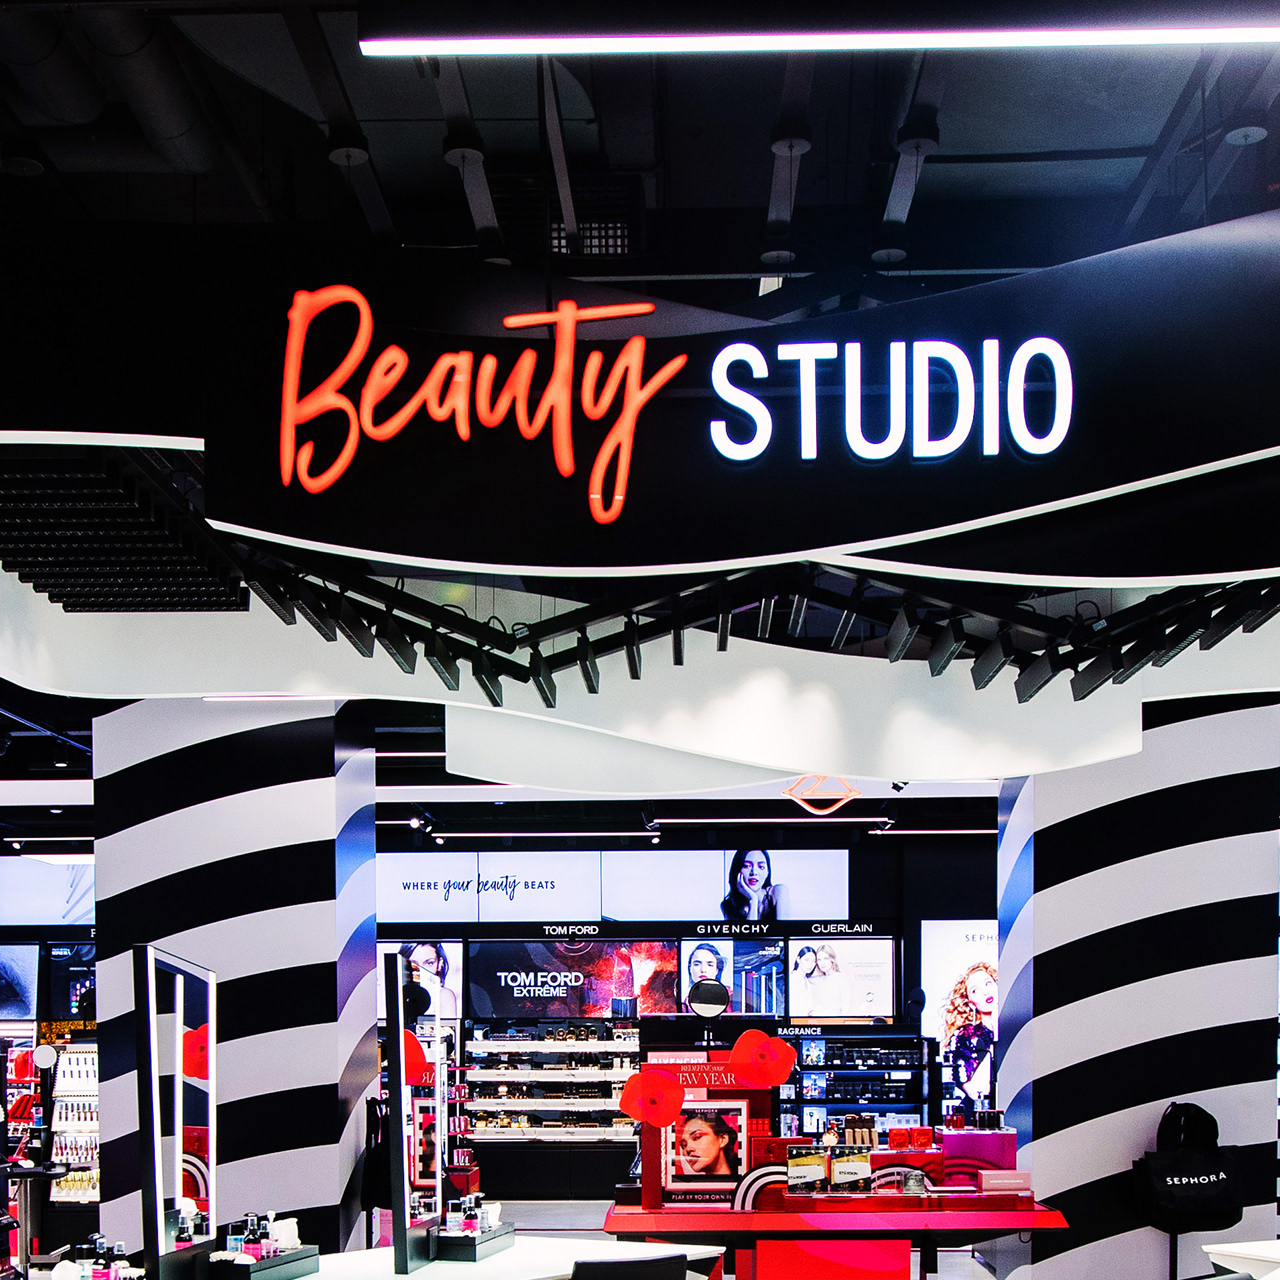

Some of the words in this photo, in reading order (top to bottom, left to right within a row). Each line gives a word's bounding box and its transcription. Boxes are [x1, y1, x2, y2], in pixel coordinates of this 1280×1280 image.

[279, 283, 688, 524] Beauty
[708, 336, 1074, 462] STUDIO
[402, 881, 439, 890] WHERE
[443, 878, 473, 901] your
[477, 872, 521, 901] beauty
[523, 880, 556, 890] BEATS
[543, 925, 568, 935] TOM
[569, 925, 599, 935] FORD
[696, 924, 770, 934] GIVENCHY
[811, 923, 873, 933] GUERLAIN
[965, 934, 999, 942] SEPHO
[496, 972, 535, 987] TOM
[536, 972, 585, 987] FORD
[513, 985, 568, 997] EXTRÊME
[777, 1027, 822, 1036] RAGRANCE
[680, 1064, 711, 1072] REDEFINE
[677, 1073, 702, 1085] EW
[702, 1073, 736, 1085] YEAR
[1165, 1171, 1227, 1185] SEPHORA
